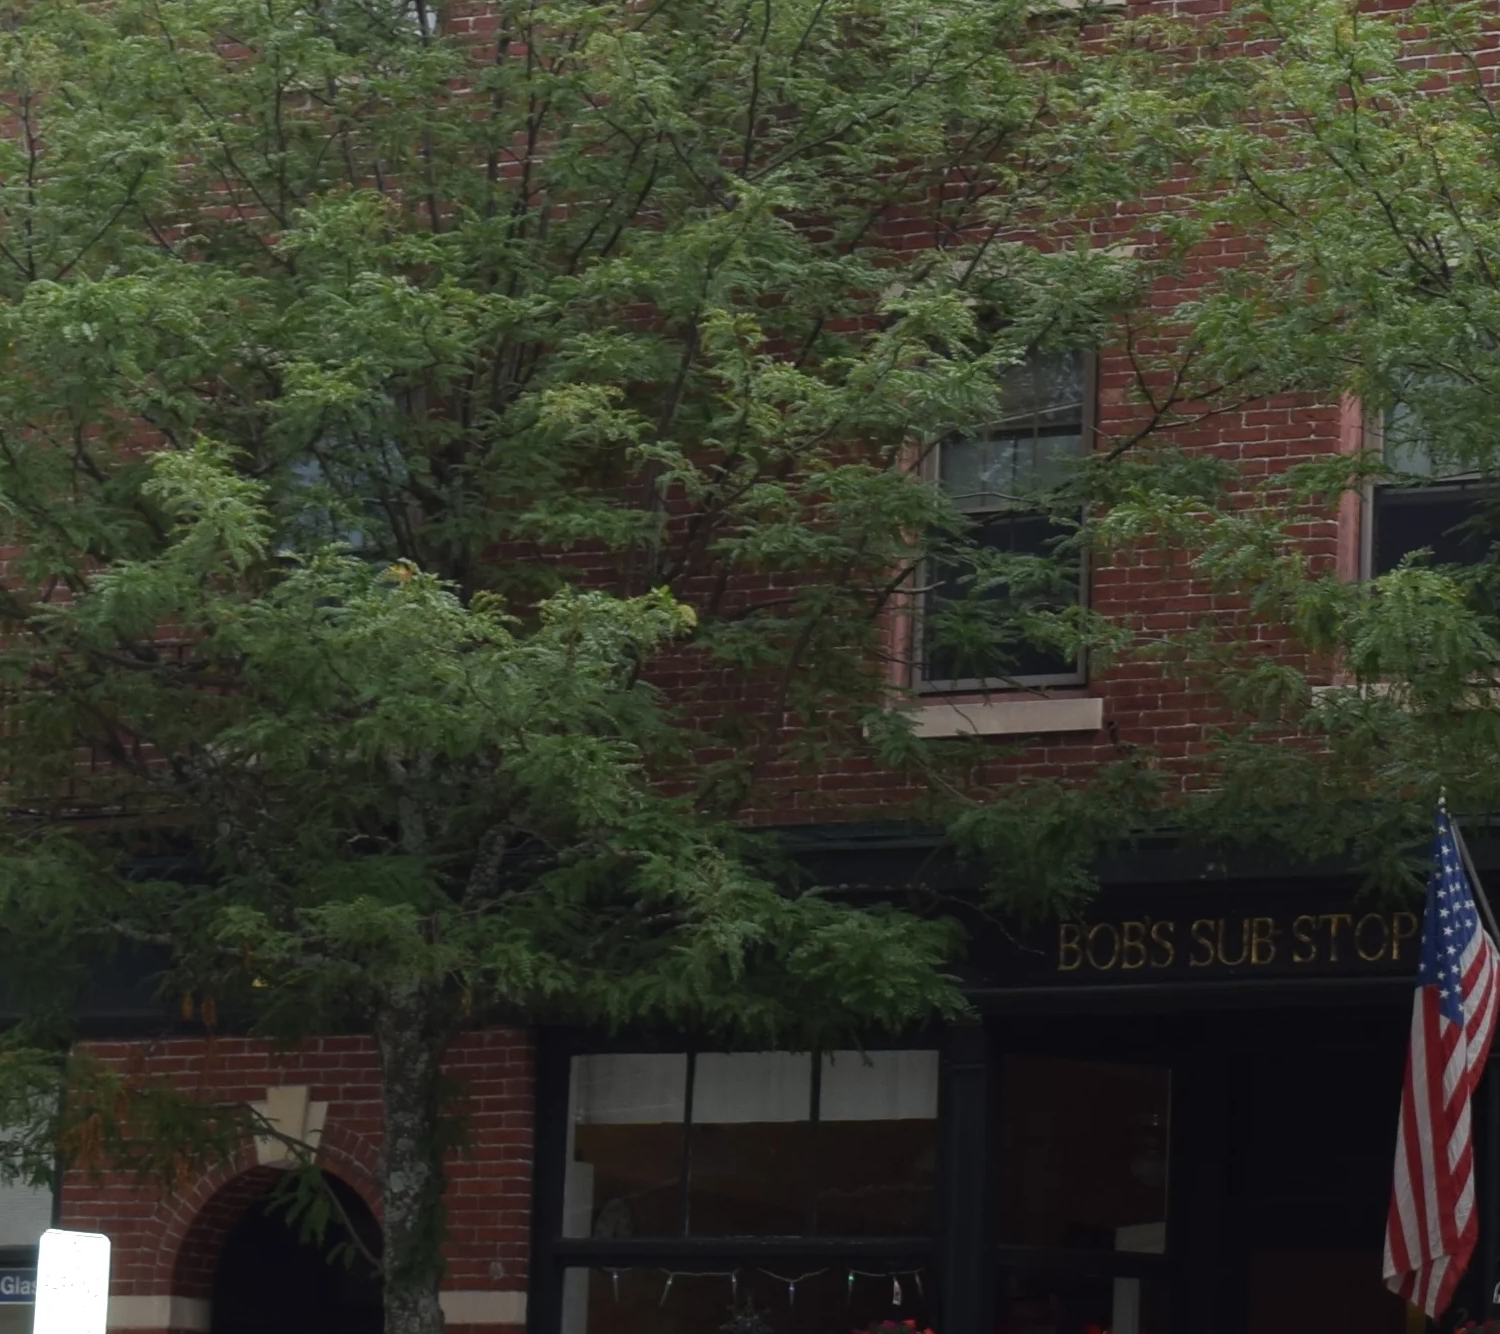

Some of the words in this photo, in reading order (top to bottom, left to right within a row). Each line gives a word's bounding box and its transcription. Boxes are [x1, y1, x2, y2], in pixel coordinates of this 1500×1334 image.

[1056, 915, 1176, 971] BOB'S
[1189, 916, 1277, 967] SUB
[1291, 912, 1419, 964] STOP
[0, 1274, 38, 1295] Glas
